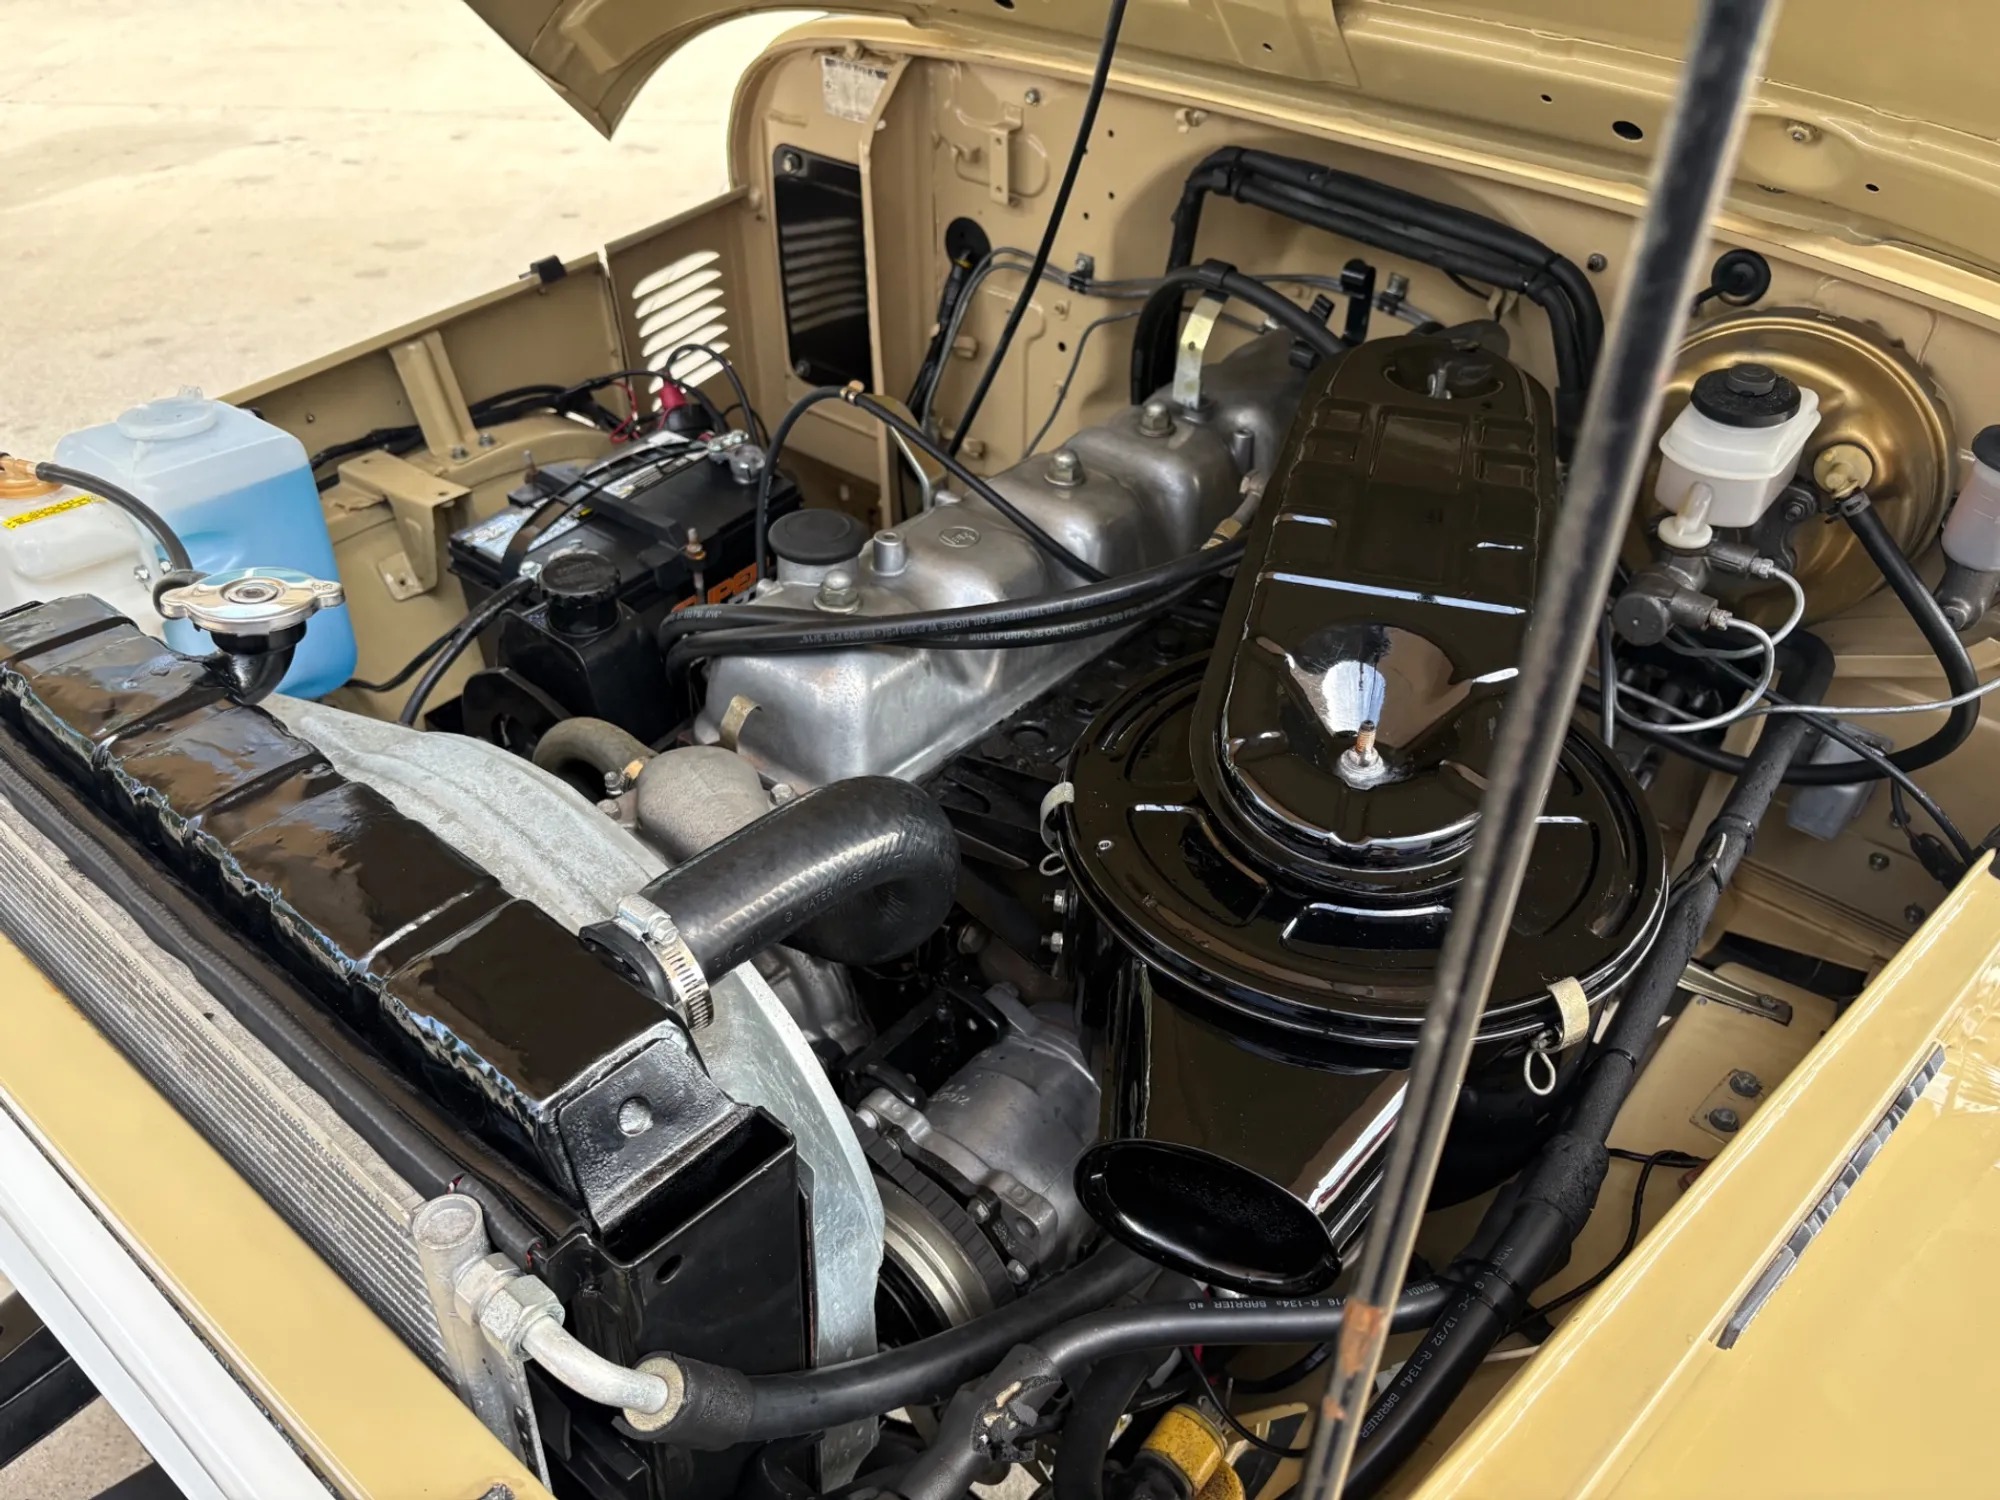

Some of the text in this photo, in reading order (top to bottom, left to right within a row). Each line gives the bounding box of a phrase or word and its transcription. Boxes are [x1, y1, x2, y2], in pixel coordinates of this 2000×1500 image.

[942, 615, 971, 631] HOSE
[968, 627, 1044, 641] MULTIPURPOSE
[1213, 1301, 1267, 1310] BARRIER
[1275, 1299, 1320, 1309] R-134a
[1430, 1315, 1459, 1347] 13/32
[1400, 1349, 1433, 1388] R-134a
[1359, 1391, 1400, 1439] BARRIER
